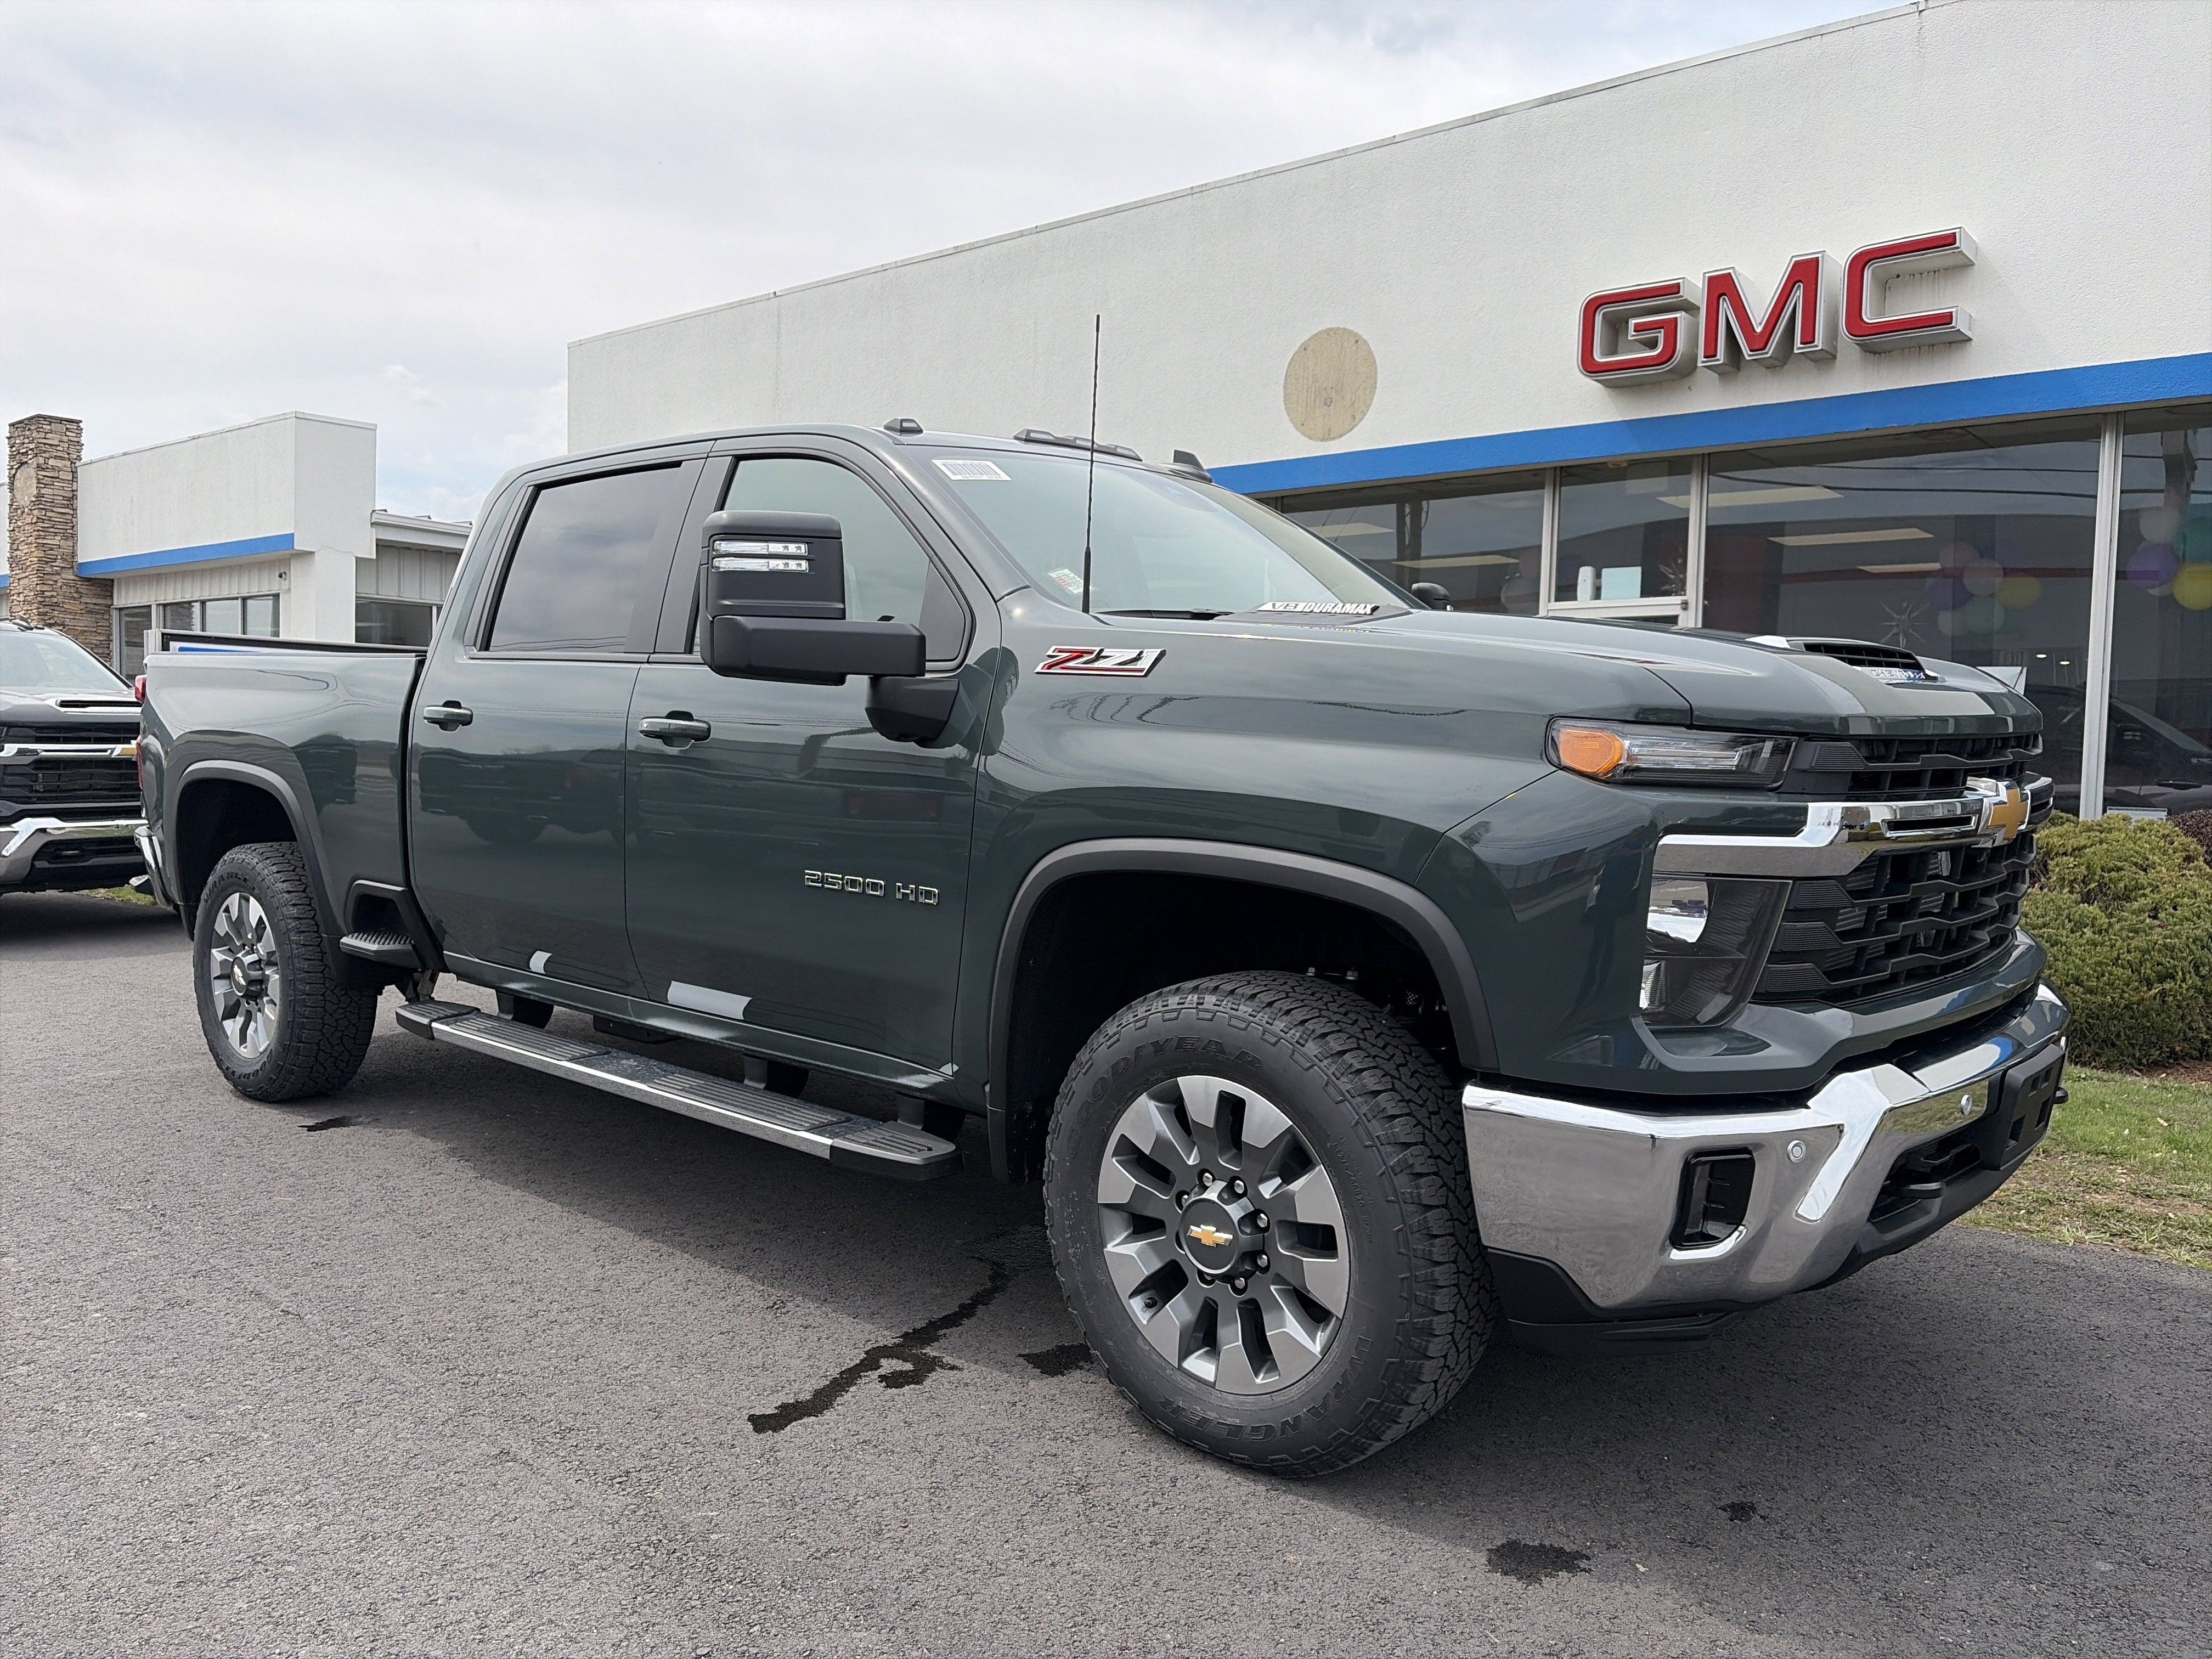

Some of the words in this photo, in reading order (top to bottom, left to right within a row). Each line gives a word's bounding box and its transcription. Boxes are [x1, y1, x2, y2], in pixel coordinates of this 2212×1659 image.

[1577, 227, 1976, 387] GMC
[1302, 602, 1376, 615] DURAMAX
[1034, 645, 1167, 678] Z71
[804, 869, 885, 897] 2500
[895, 882, 940, 905] HD
[1066, 1035, 1262, 1159] GOODYEAR
[1158, 1334, 1373, 1442] WRANGLER
